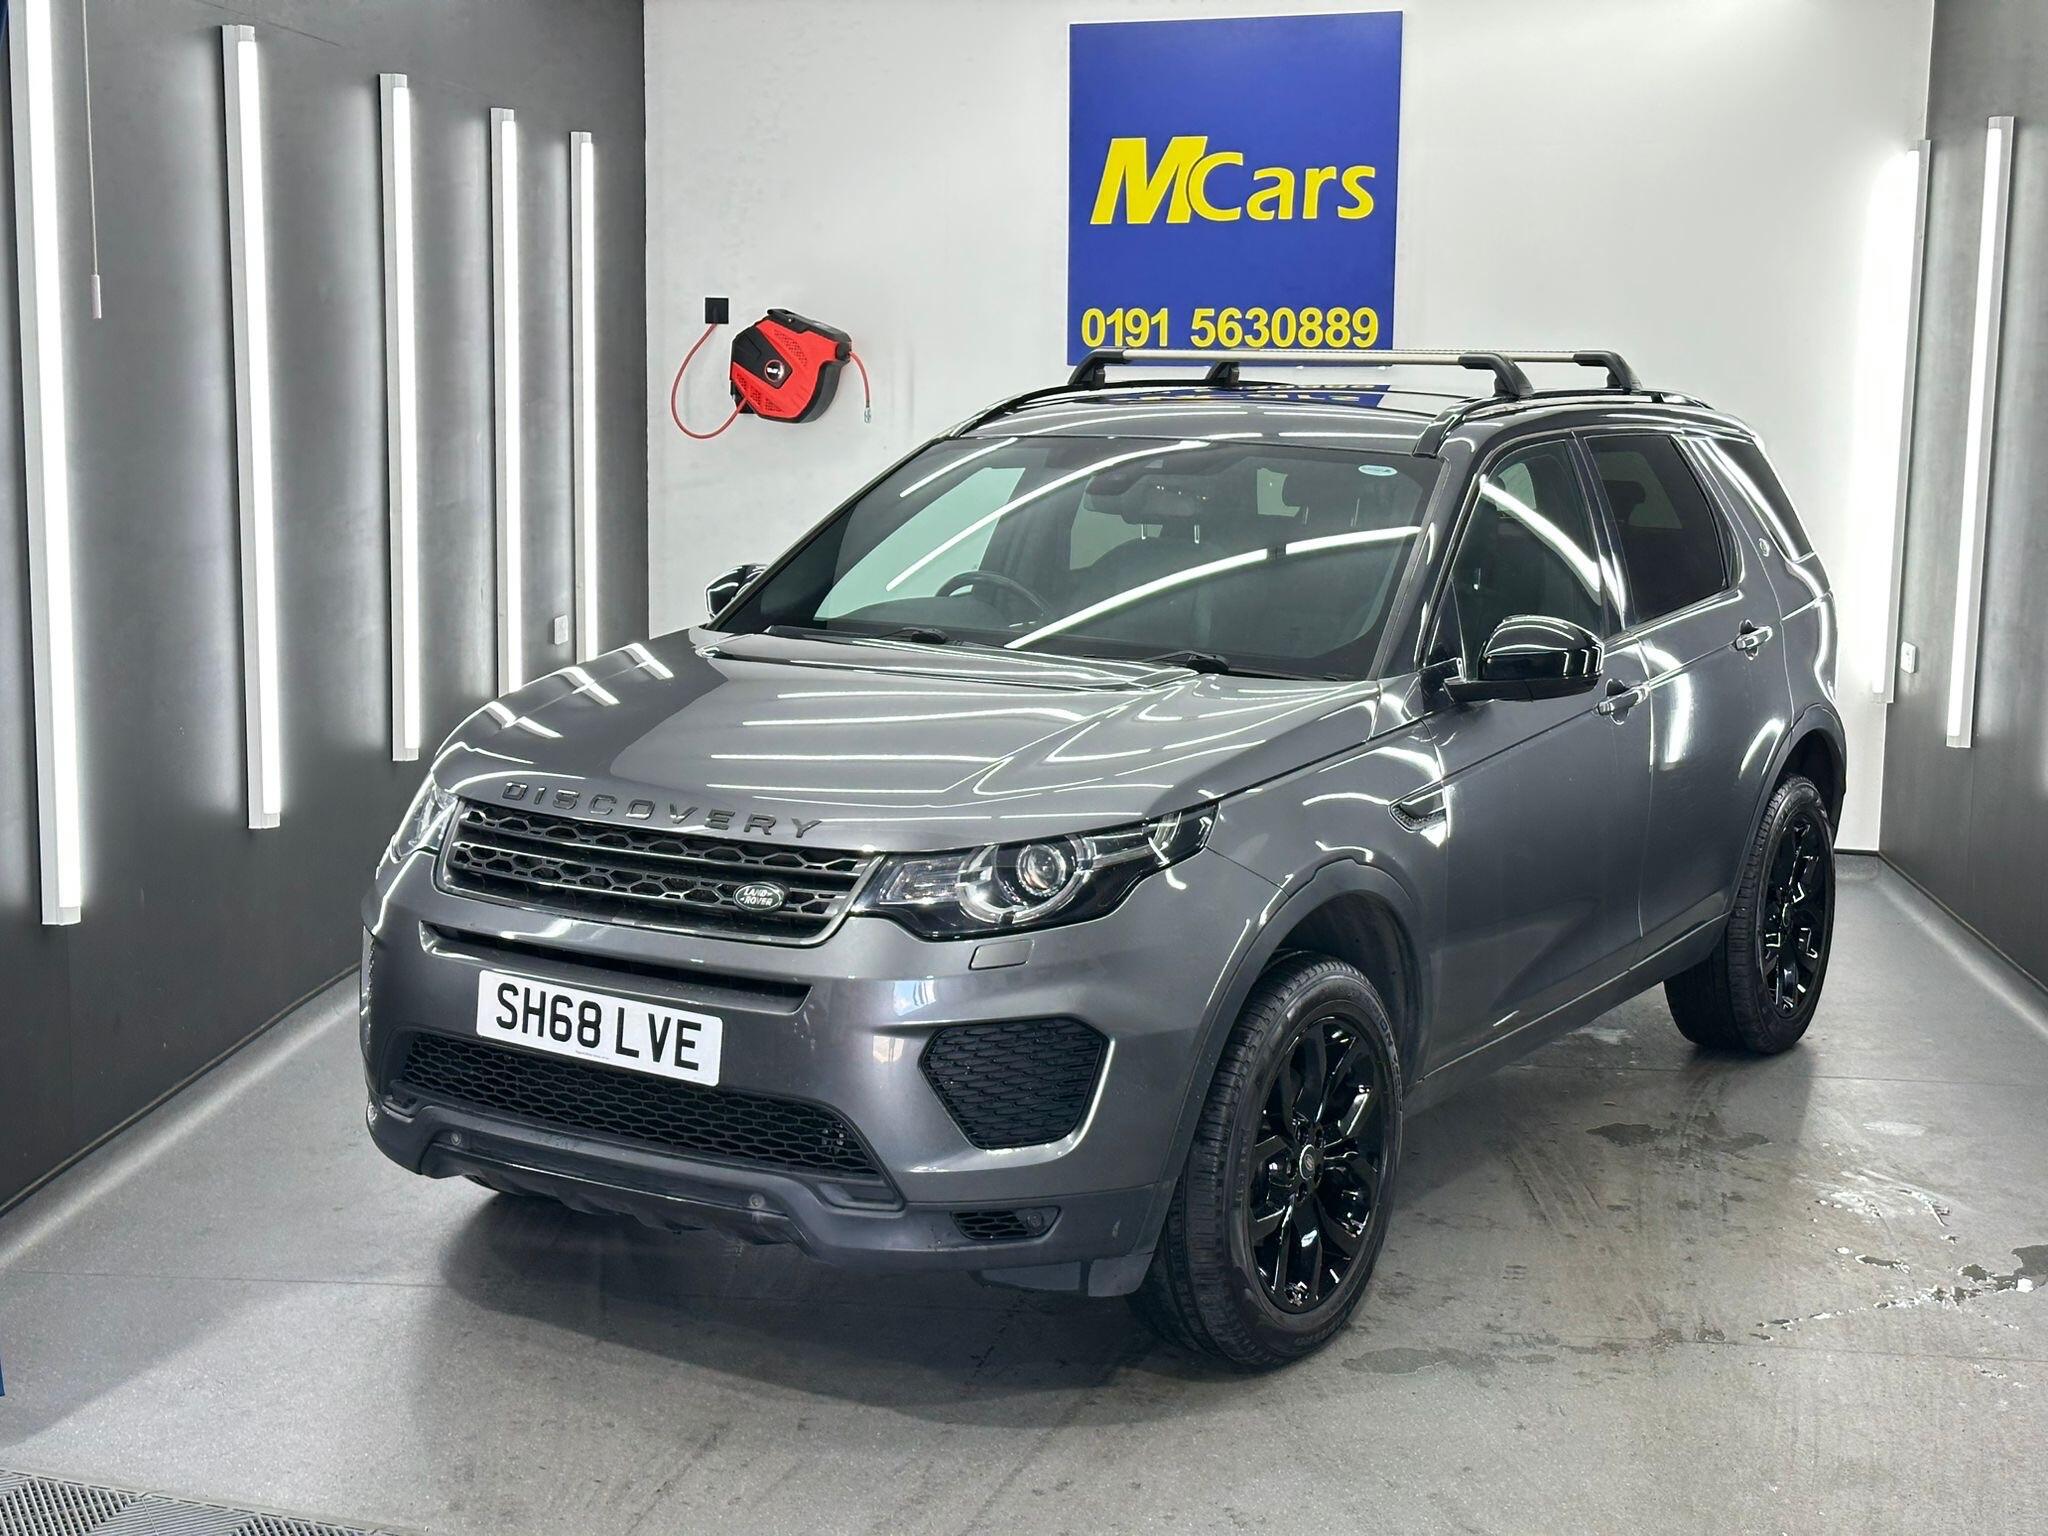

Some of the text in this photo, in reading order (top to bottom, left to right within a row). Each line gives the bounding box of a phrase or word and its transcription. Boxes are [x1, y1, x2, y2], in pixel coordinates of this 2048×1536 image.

[1081, 307, 1378, 347] 0191 5630889
[502, 782, 822, 839] DISCOVERY
[743, 887, 769, 898] LAND
[743, 895, 773, 907] ROVER
[496, 983, 702, 1071] SH68 LVE
